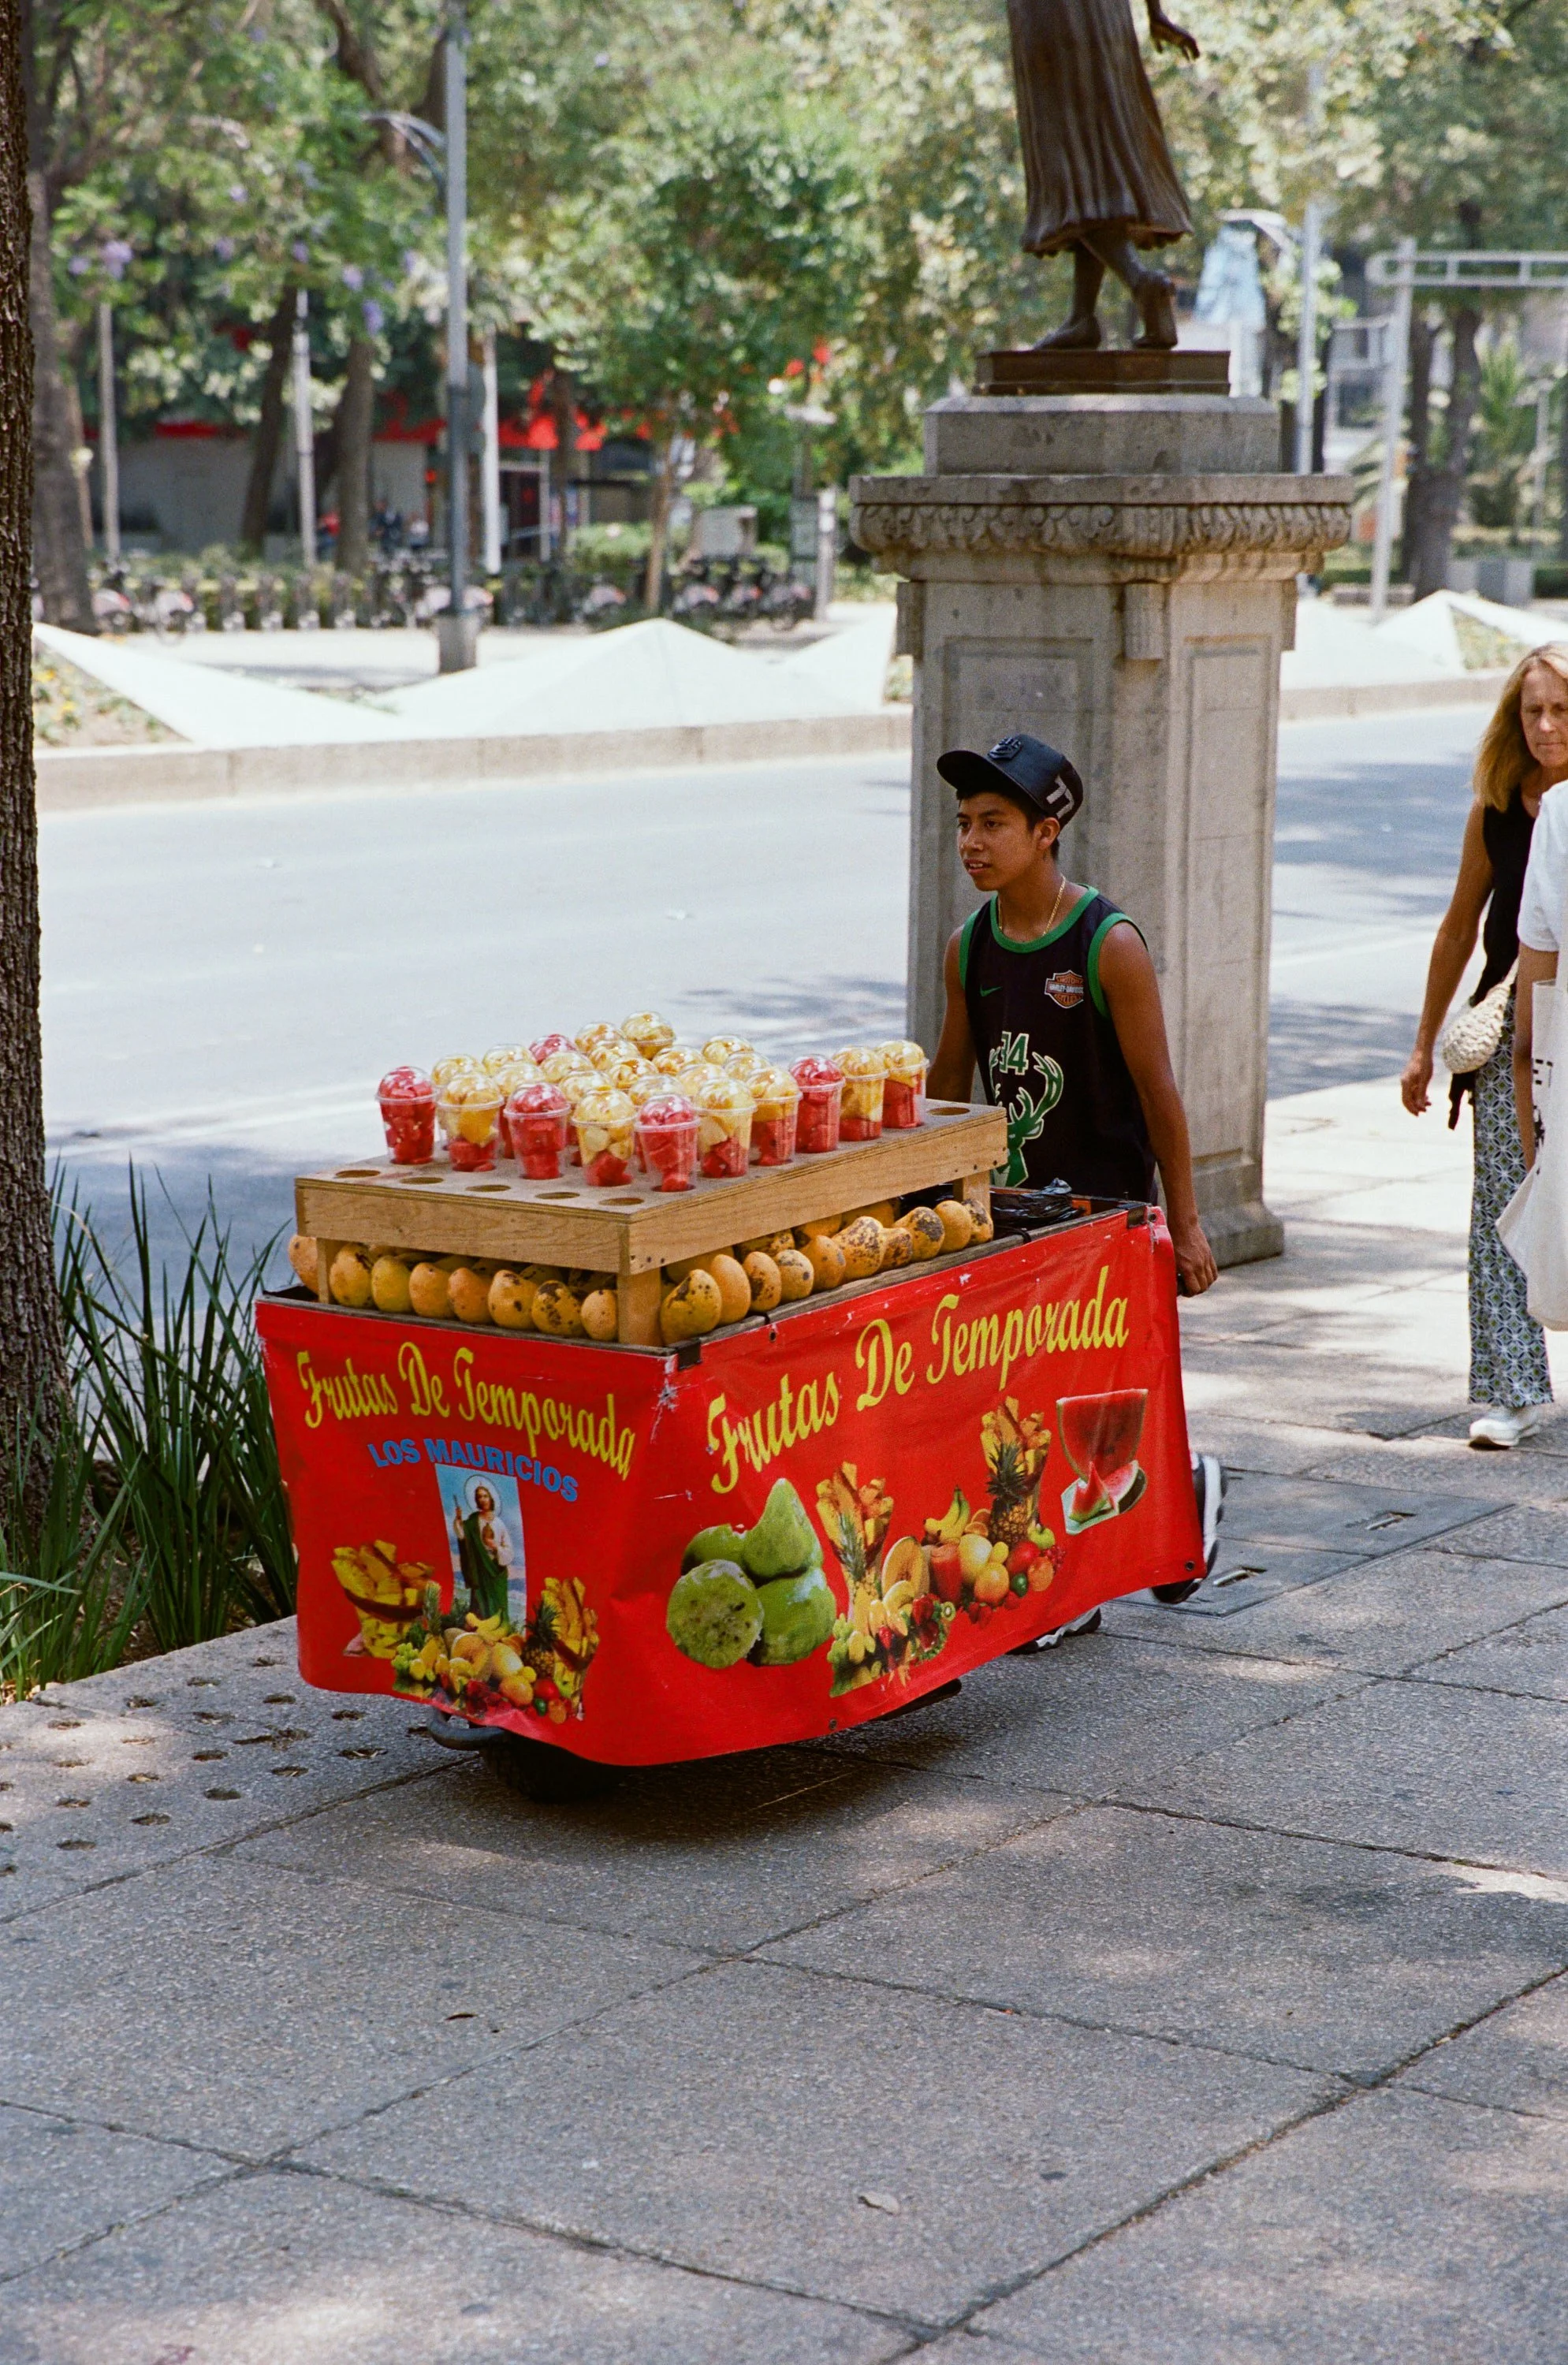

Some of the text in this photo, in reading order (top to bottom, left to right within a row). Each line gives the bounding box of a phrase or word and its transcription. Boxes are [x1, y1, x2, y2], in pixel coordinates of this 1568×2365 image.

[999, 1030, 1030, 1076] 34
[296, 1341, 635, 1480] Frutas De Temporada
[706, 1265, 1130, 1495] Frutas De Temporada
[367, 1438, 578, 1503] LOS MAURICIOS
